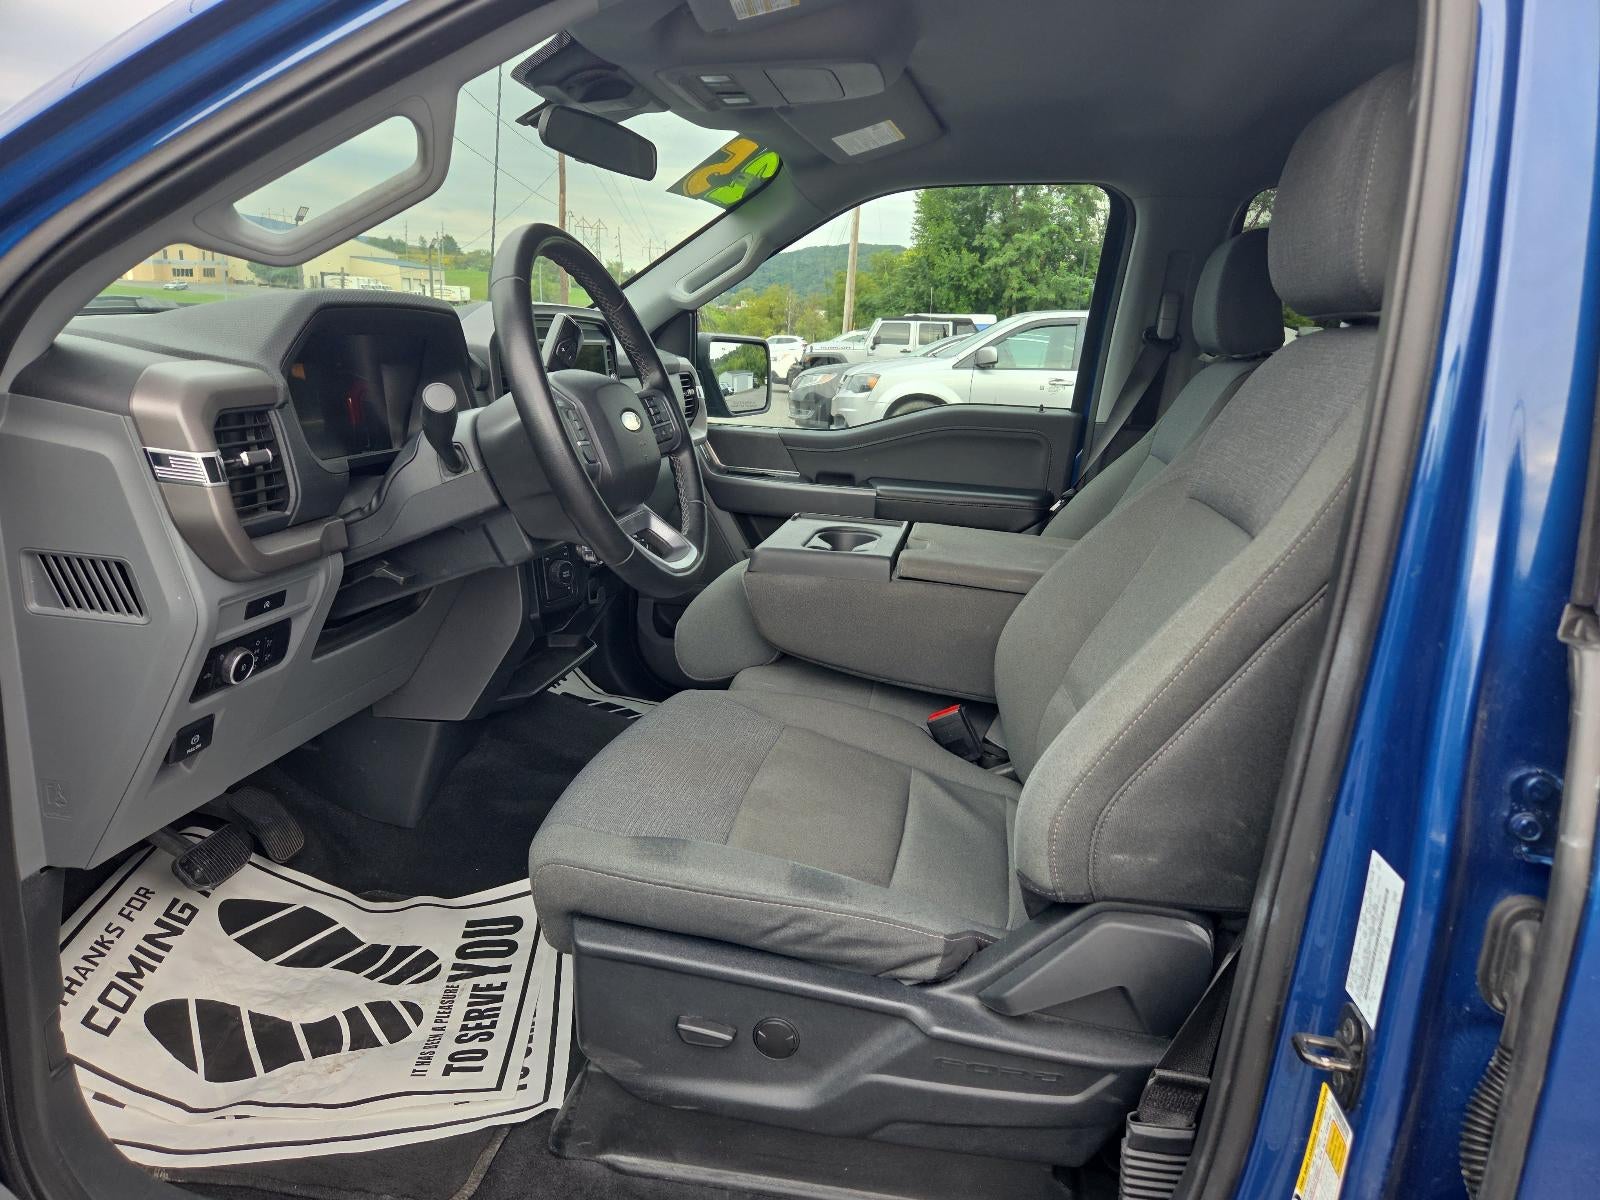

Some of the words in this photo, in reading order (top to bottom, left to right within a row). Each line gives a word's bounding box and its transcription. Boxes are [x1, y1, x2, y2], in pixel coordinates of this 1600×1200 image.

[118, 886, 156, 922] FOR
[80, 897, 200, 1037] COMING
[446, 915, 524, 983] YOU
[434, 984, 460, 1024] PLEASURE
[454, 981, 508, 1045] SERVE
[415, 1050, 436, 1066] HAS
[422, 1033, 444, 1050] BEEN
[410, 1068, 428, 1077] IT
[441, 1048, 489, 1077] TO
